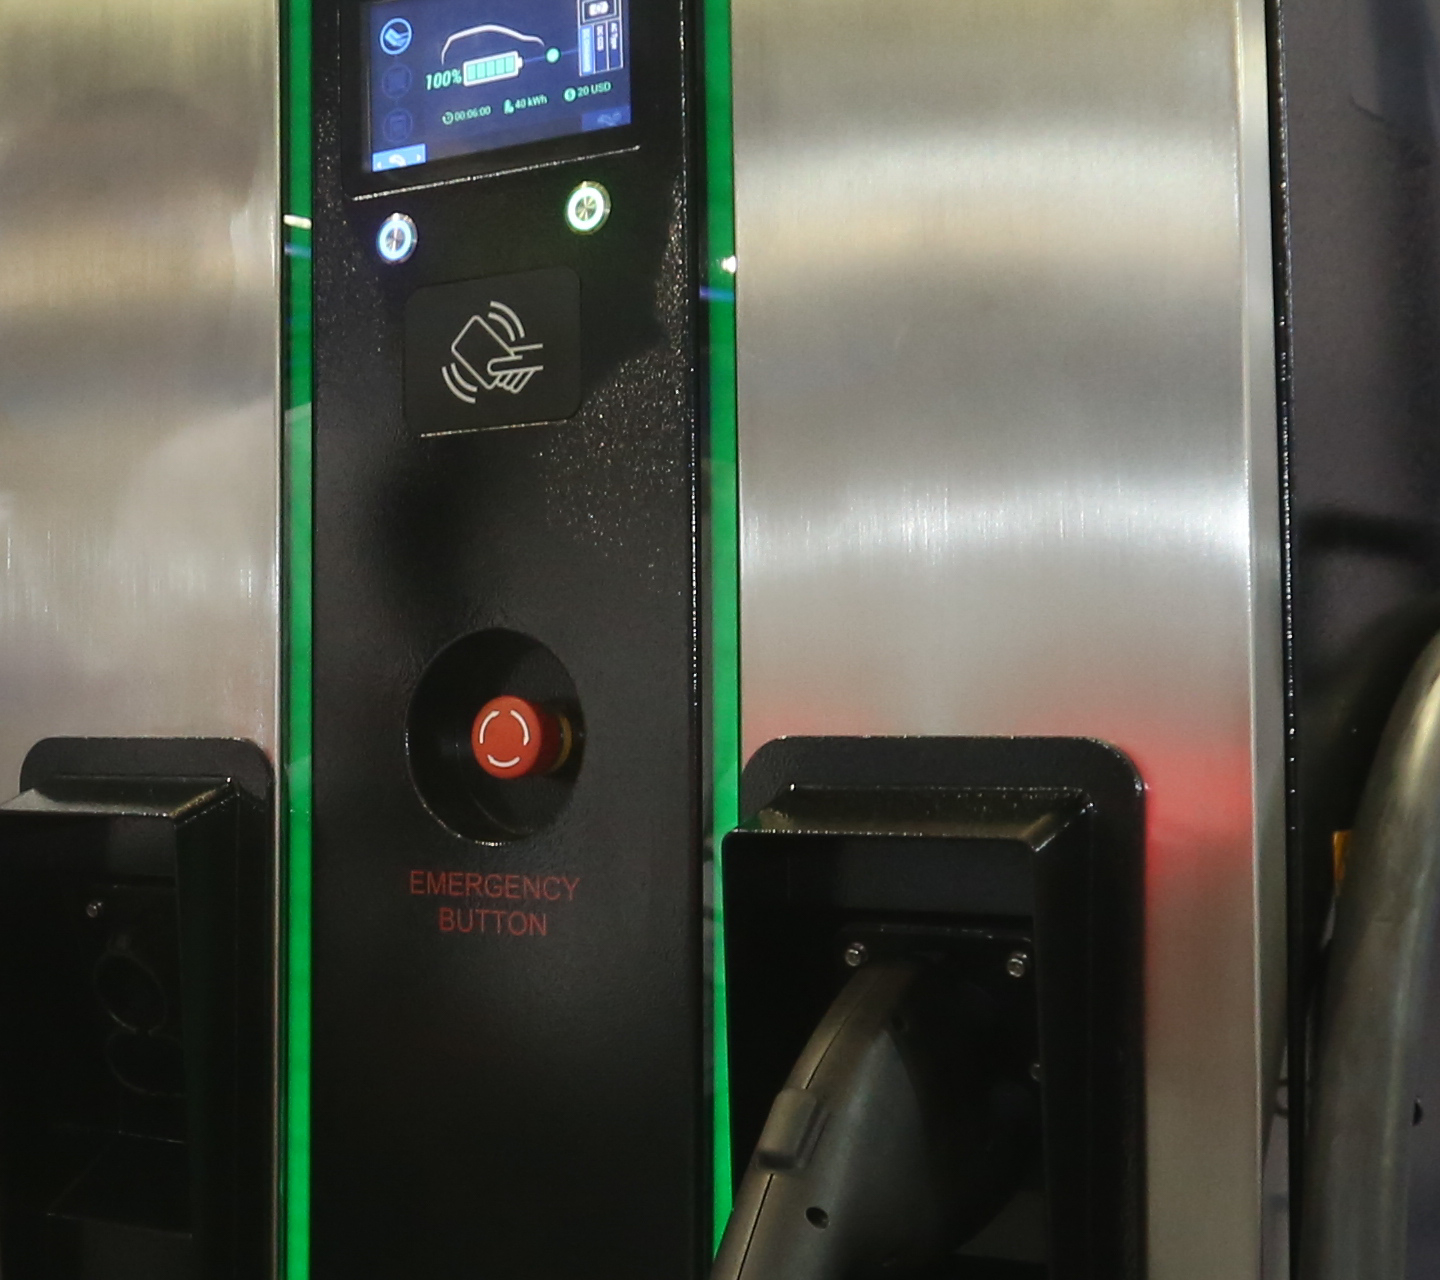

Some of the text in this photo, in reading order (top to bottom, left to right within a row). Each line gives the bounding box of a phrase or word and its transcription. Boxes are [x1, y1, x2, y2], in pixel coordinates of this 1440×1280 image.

[425, 68, 462, 91] 100%
[591, 81, 612, 95] USD
[409, 870, 580, 902] EMERGENCY
[438, 907, 547, 936] BUTTON
